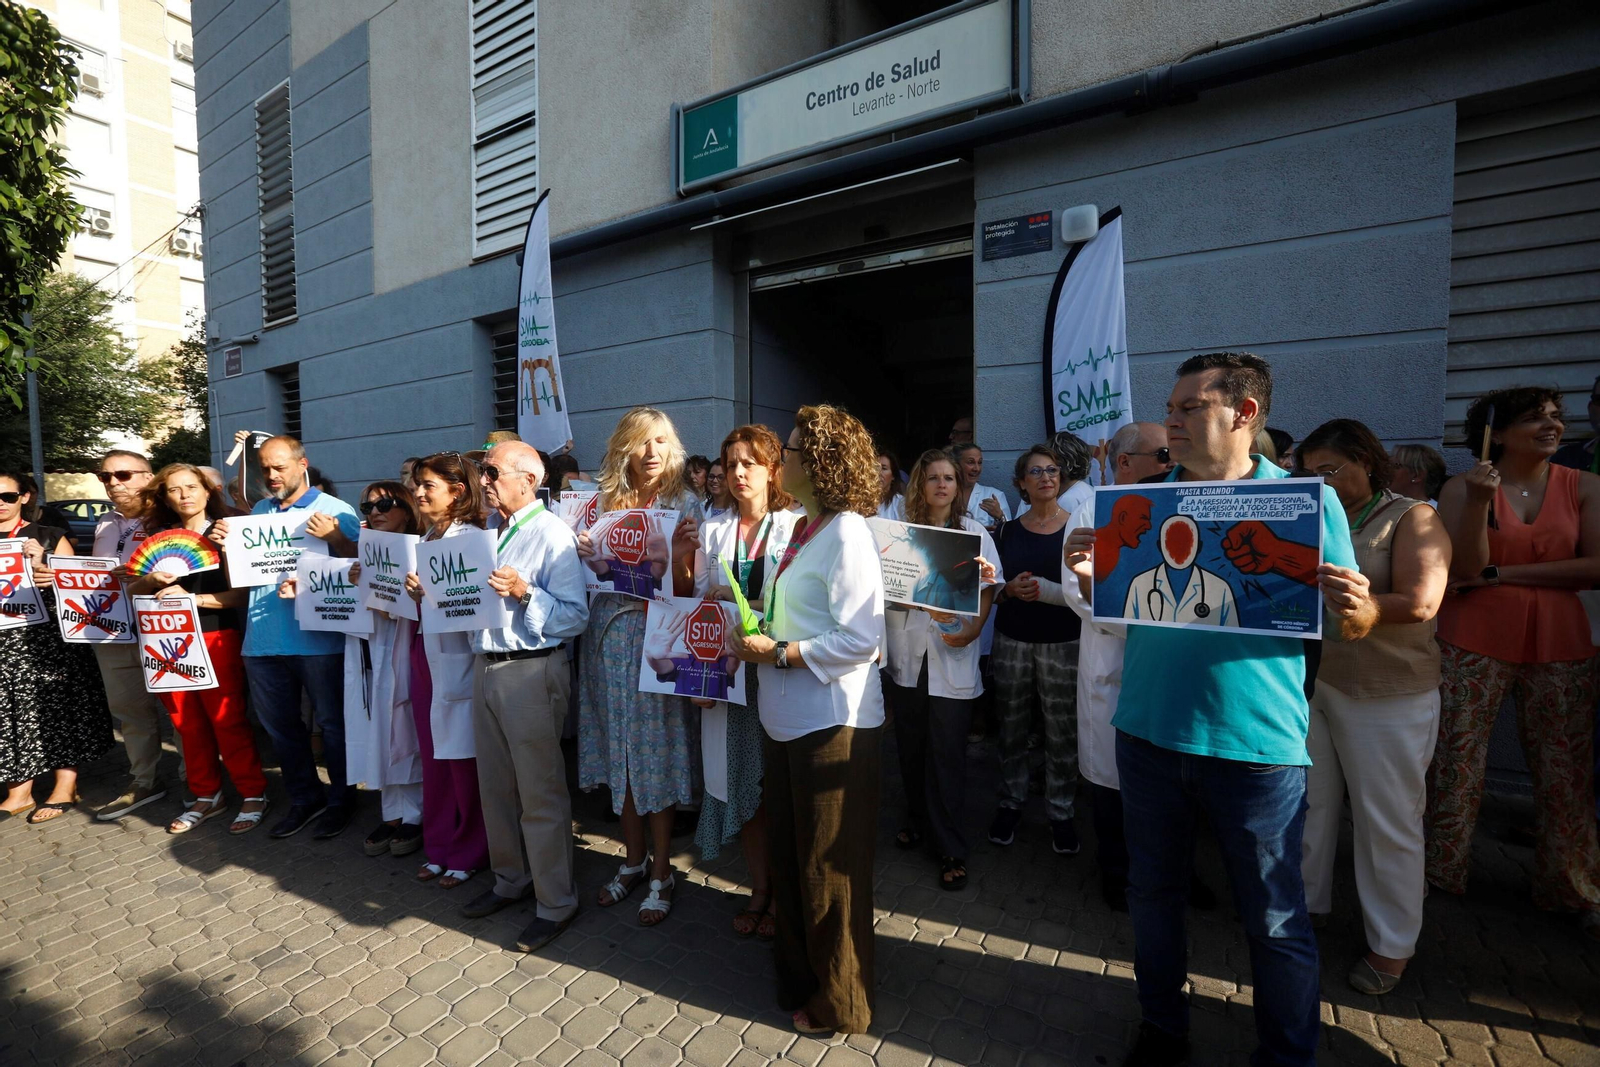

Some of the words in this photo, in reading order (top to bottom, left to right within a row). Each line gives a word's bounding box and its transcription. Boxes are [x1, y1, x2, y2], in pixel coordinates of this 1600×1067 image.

[805, 82, 860, 111] Centro
[865, 71, 885, 92] de
[890, 49, 941, 83] Salud
[852, 92, 896, 116] Levante
[907, 78, 941, 99] Norte
[985, 220, 1019, 232] Instalación
[985, 228, 1015, 241] protegida
[520, 315, 550, 337] SMA
[1058, 378, 1122, 417] SMA
[1065, 409, 1124, 432] CÓRDOBA
[1202, 486, 1235, 495] CUANDO?
[1186, 498, 1195, 506] LA
[1253, 497, 1307, 505] PROFESIONAL
[1281, 503, 1313, 511] SISTEMA
[1212, 511, 1233, 519] TIENE
[1250, 510, 1294, 518] ATENDERTE
[242, 525, 304, 550] SMA
[611, 528, 643, 547] STOP
[365, 542, 400, 574] SMA
[613, 545, 640, 555] AGRESIONES
[251, 559, 282, 567] SINDICATO
[430, 550, 478, 586] SMA
[59, 572, 112, 588] STOP
[309, 568, 355, 596] SMA
[884, 575, 907, 589] SMA
[387, 585, 401, 596] MÉDICO
[82, 593, 113, 615] NO
[338, 605, 355, 613] MÉDICO
[437, 600, 460, 608] SINDICATO
[461, 596, 480, 606] MÉDICO
[62, 609, 127, 633] AGRESIONES
[328, 612, 349, 620] CÓRDOBA
[445, 610, 451, 618] DE
[451, 608, 476, 617] CÓRDOBA
[140, 613, 187, 632] STOP
[691, 621, 721, 641] STOP
[159, 637, 189, 662] NO
[692, 641, 720, 650] AGRESIONES
[144, 656, 206, 678] AGRESIONES
